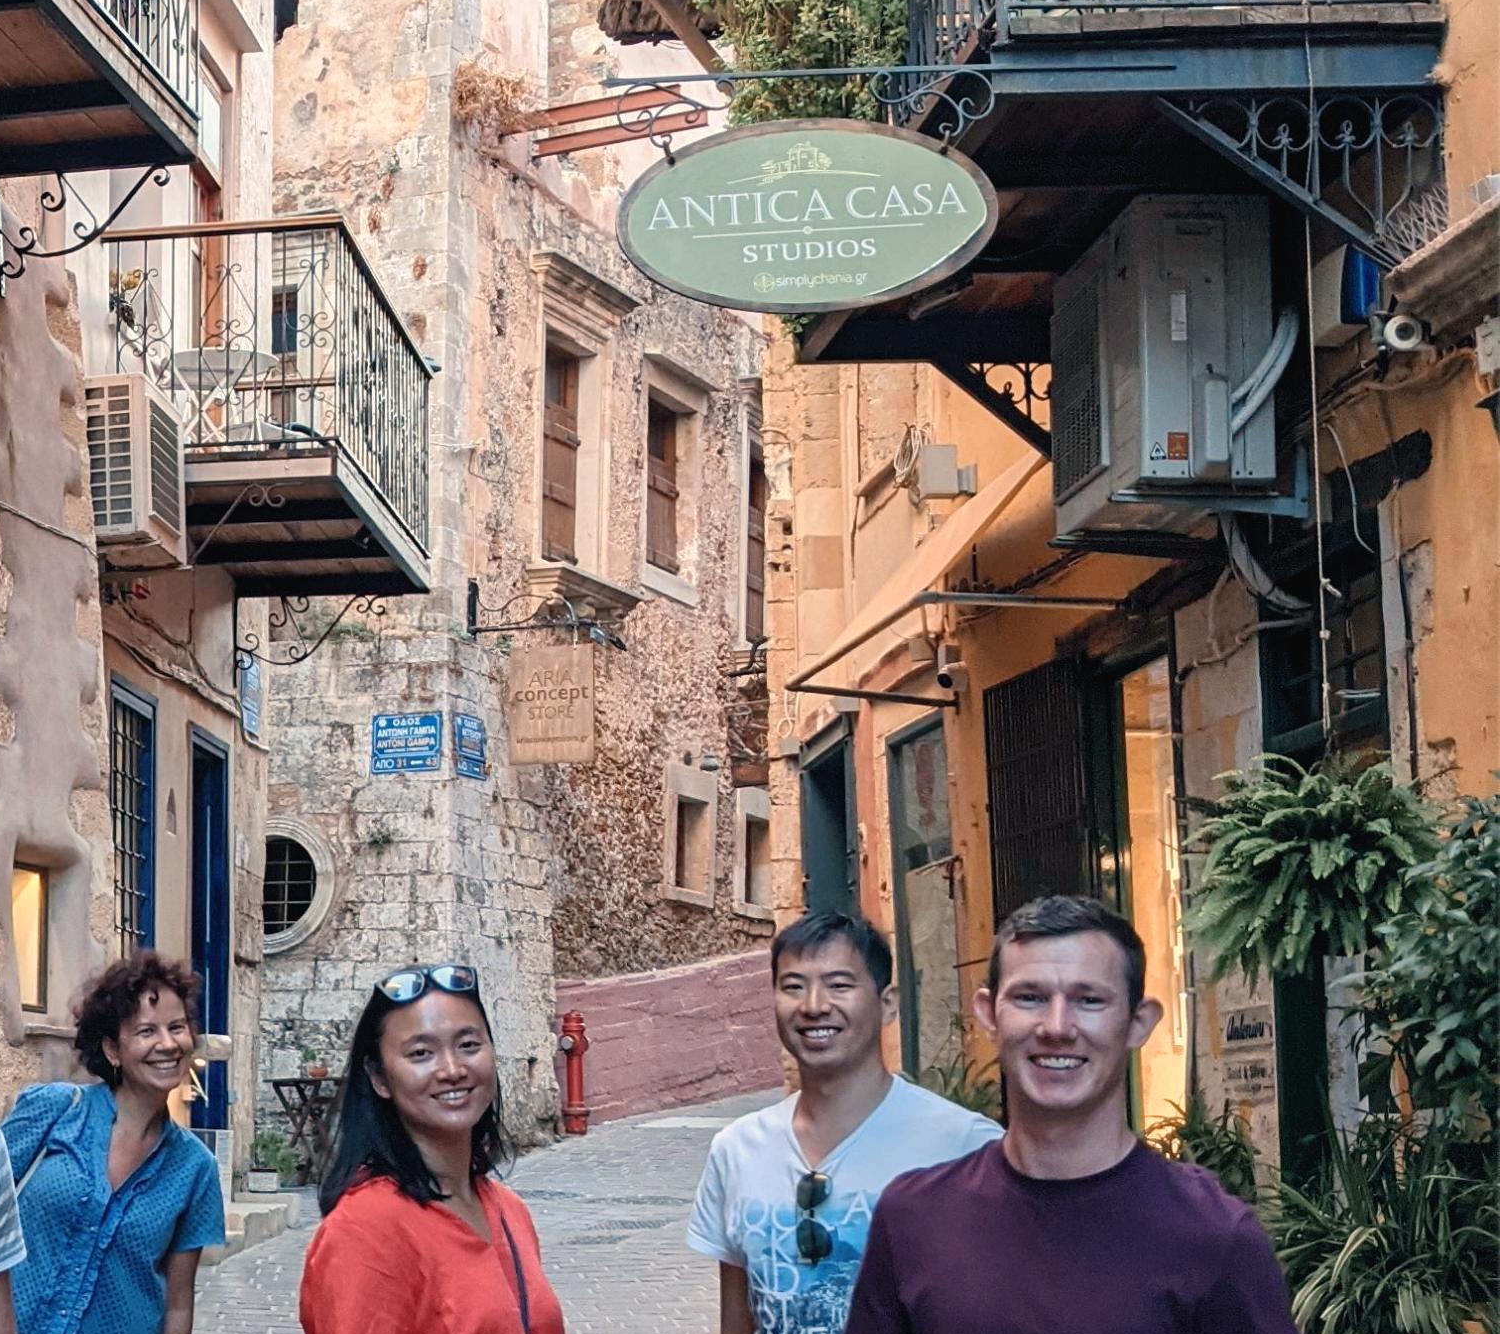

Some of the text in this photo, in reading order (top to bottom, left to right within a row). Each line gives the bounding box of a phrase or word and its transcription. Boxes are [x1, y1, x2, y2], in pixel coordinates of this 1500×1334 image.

[645, 182, 969, 231] ANTICA CASA
[742, 238, 877, 264] STUDIOS
[775, 271, 868, 289] simplychania.gr
[529, 668, 575, 688] ARIA
[514, 686, 589, 704] concept
[527, 704, 576, 720] STORE
[392, 717, 421, 727] ΟΔΟΣ
